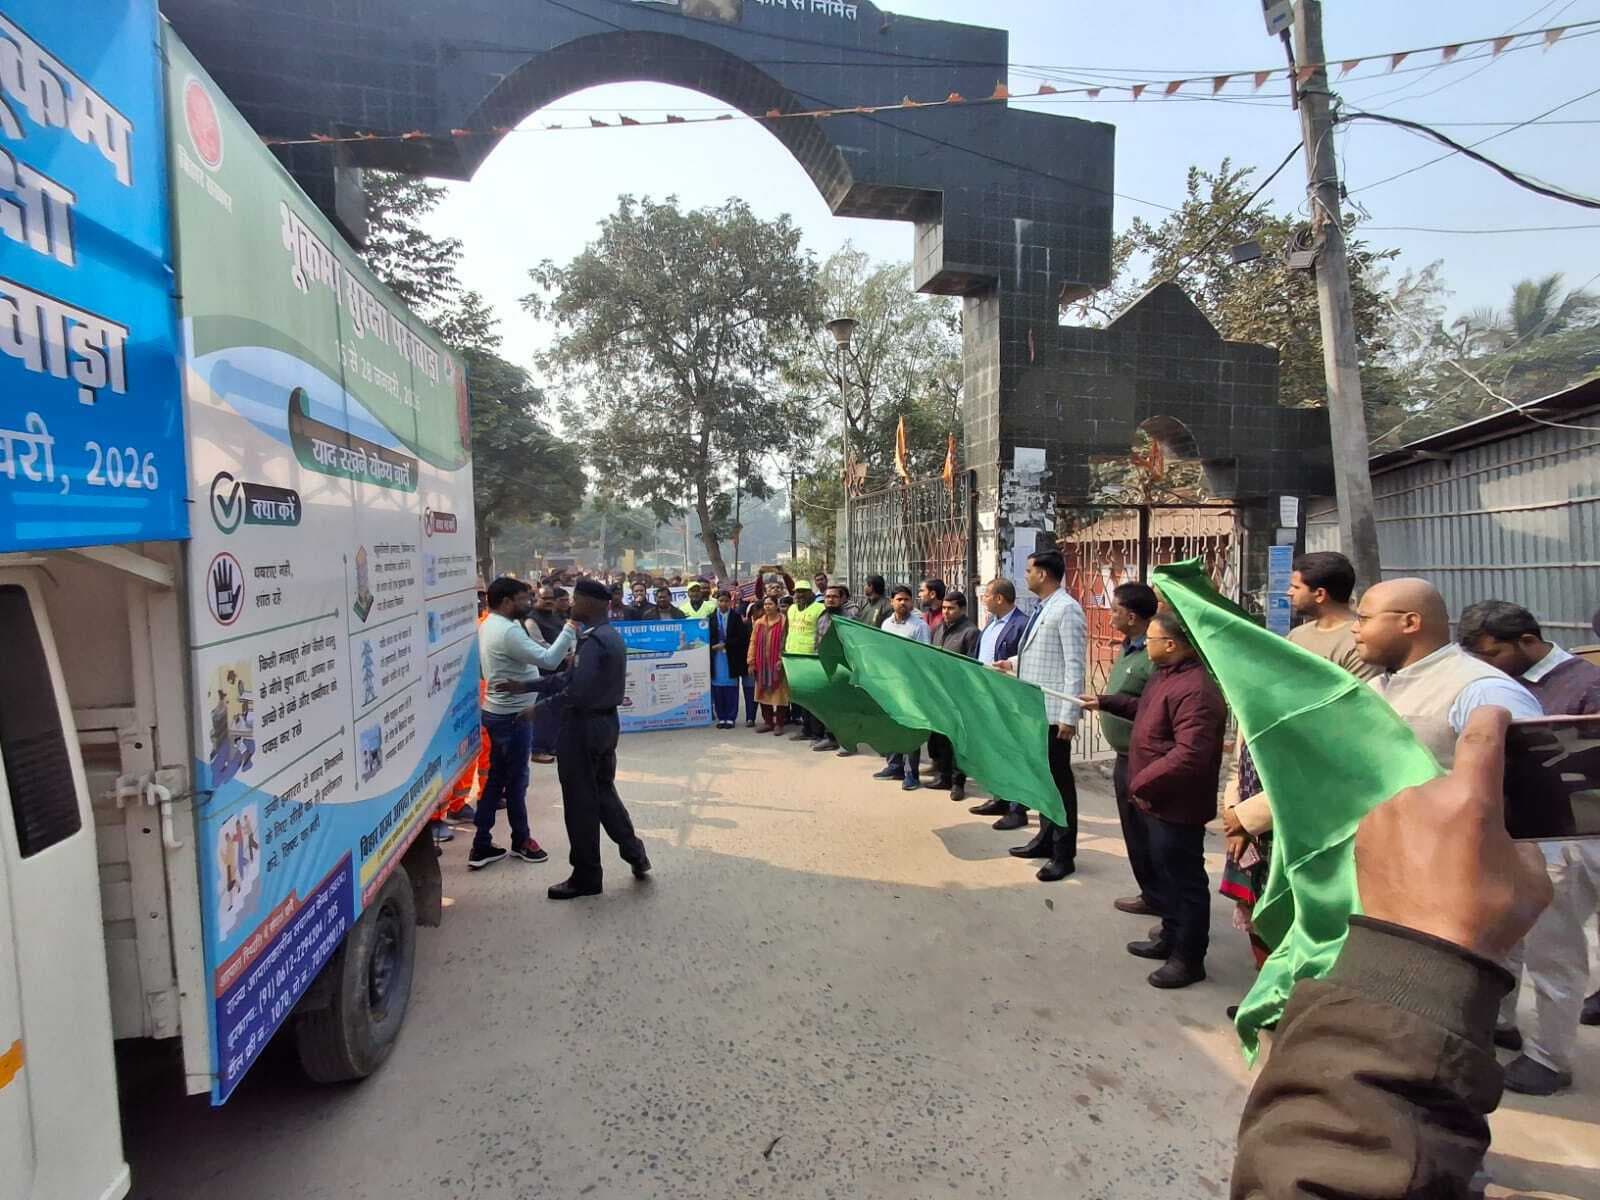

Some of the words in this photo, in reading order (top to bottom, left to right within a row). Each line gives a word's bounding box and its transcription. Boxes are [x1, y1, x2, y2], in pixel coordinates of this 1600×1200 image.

[0, 276, 129, 406] वाड़ा
[85, 441, 159, 490] 2026
[311, 438, 337, 468] याद
[339, 447, 368, 475] रखने
[368, 452, 393, 482] योग्य
[393, 462, 410, 487] बातें
[250, 498, 276, 520] क्या
[276, 495, 296, 521] करें
